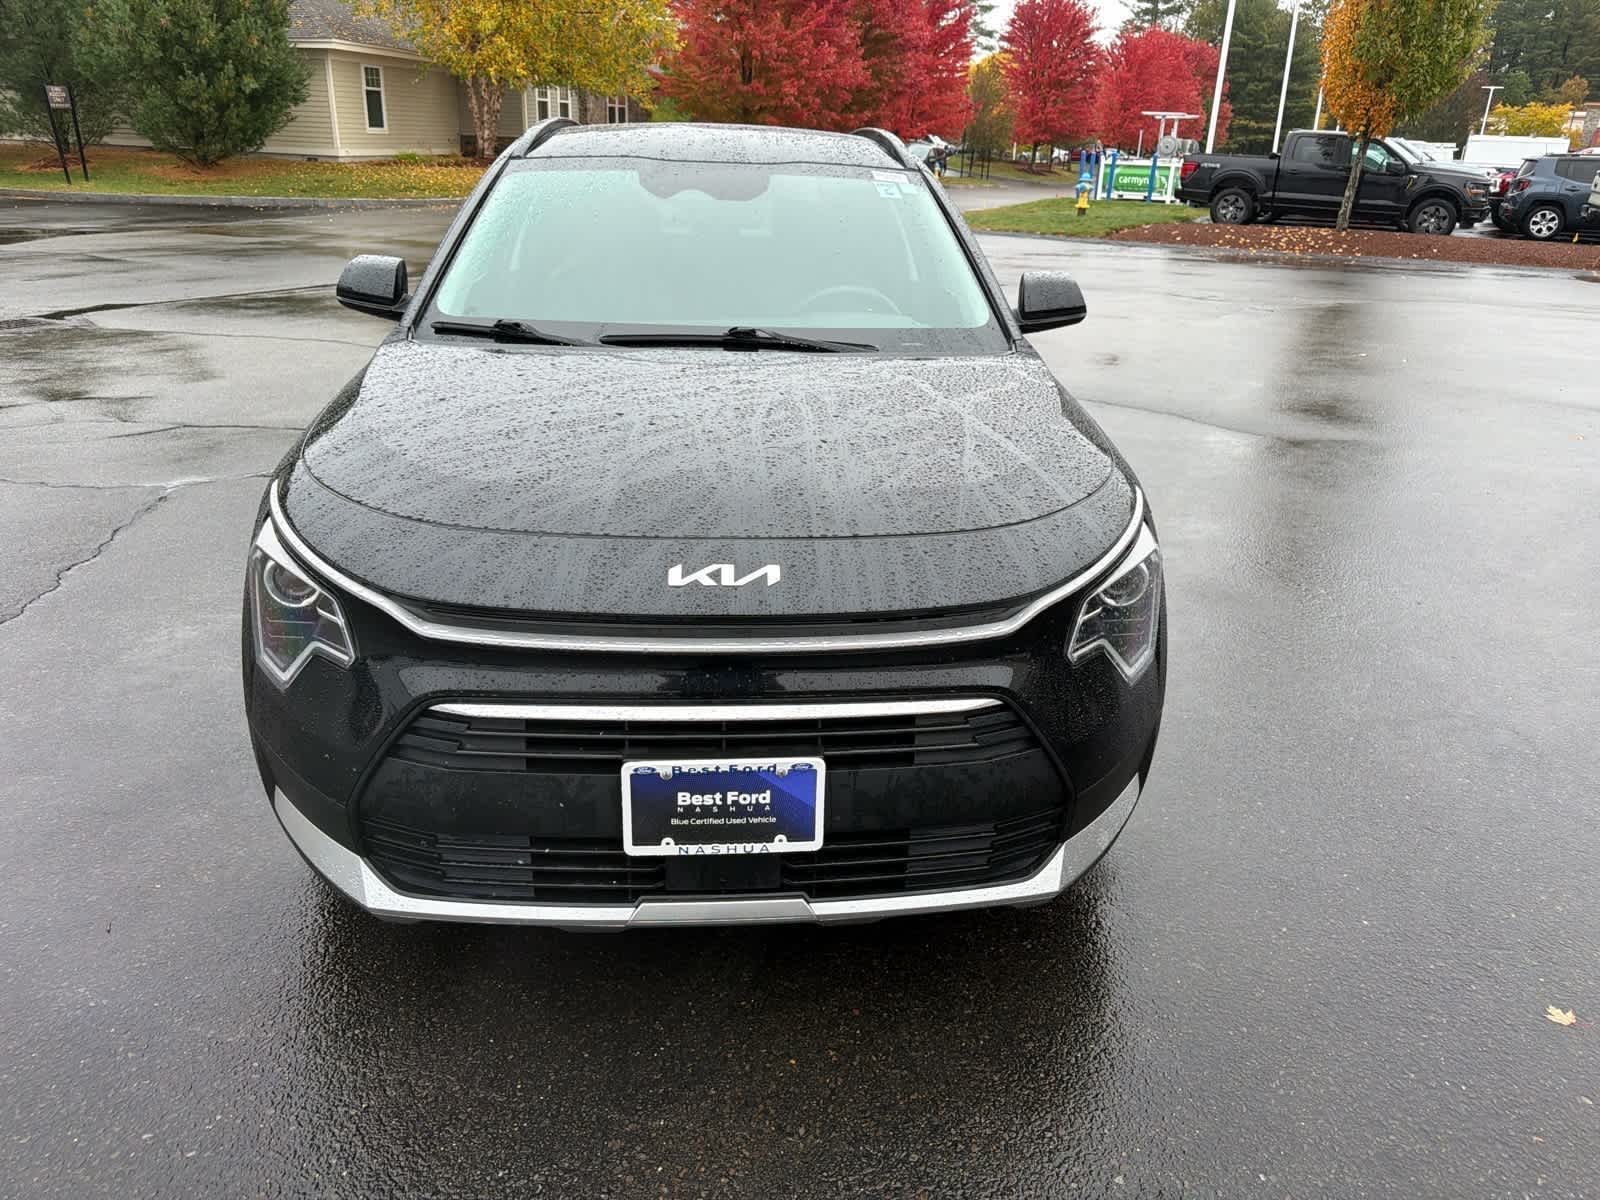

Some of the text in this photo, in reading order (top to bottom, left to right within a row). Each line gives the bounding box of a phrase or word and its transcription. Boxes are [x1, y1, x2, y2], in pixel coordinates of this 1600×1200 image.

[667, 563, 781, 586] KIA
[671, 763, 777, 774] Best Ford
[677, 790, 771, 806] Best Ford
[677, 805, 771, 813] NASHUA
[670, 815, 777, 825] Blue Certified Used Vehicle
[678, 844, 771, 855] NASHUA
